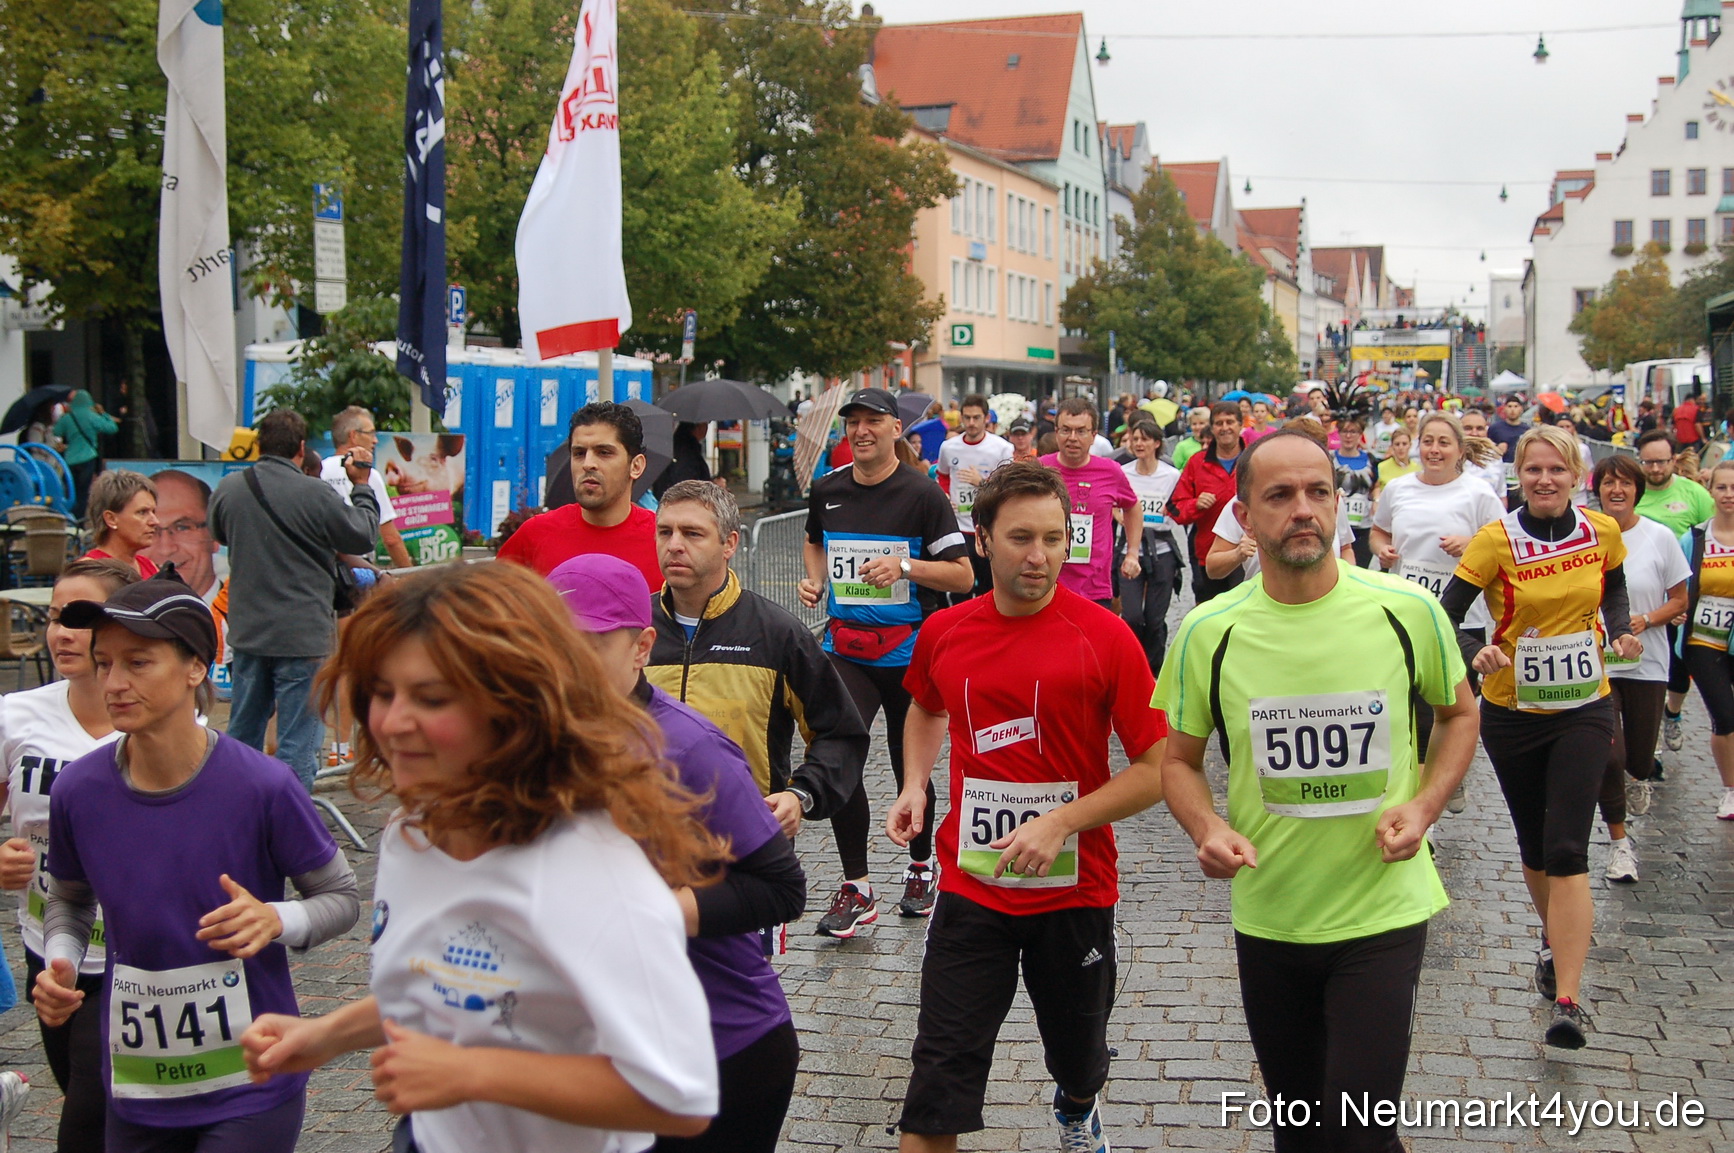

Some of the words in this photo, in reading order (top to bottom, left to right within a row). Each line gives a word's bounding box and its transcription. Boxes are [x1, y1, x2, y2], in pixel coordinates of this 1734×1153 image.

[452, 290, 462, 321] P
[953, 326, 971, 344] D
[1517, 564, 1557, 582] MAX
[1562, 551, 1602, 573] BÖGL
[845, 586, 870, 596] Klaus
[1518, 645, 1544, 653] PARTL
[1545, 641, 1584, 653] Neumarkt
[1523, 650, 1594, 683] 5116
[1538, 686, 1582, 700] Daniela
[1252, 709, 1296, 721] PARTL
[1299, 704, 1363, 719] Neumarkt
[992, 726, 1020, 743] DEHN
[1265, 721, 1376, 771] 5097
[964, 789, 999, 803] PARTL
[1001, 793, 1057, 804] Neumarkt
[1300, 782, 1347, 799] Peter
[113, 978, 145, 996] PARTL
[147, 978, 217, 997] Neumarkt
[121, 995, 232, 1050] 5141
[155, 1062, 207, 1080] Petra
